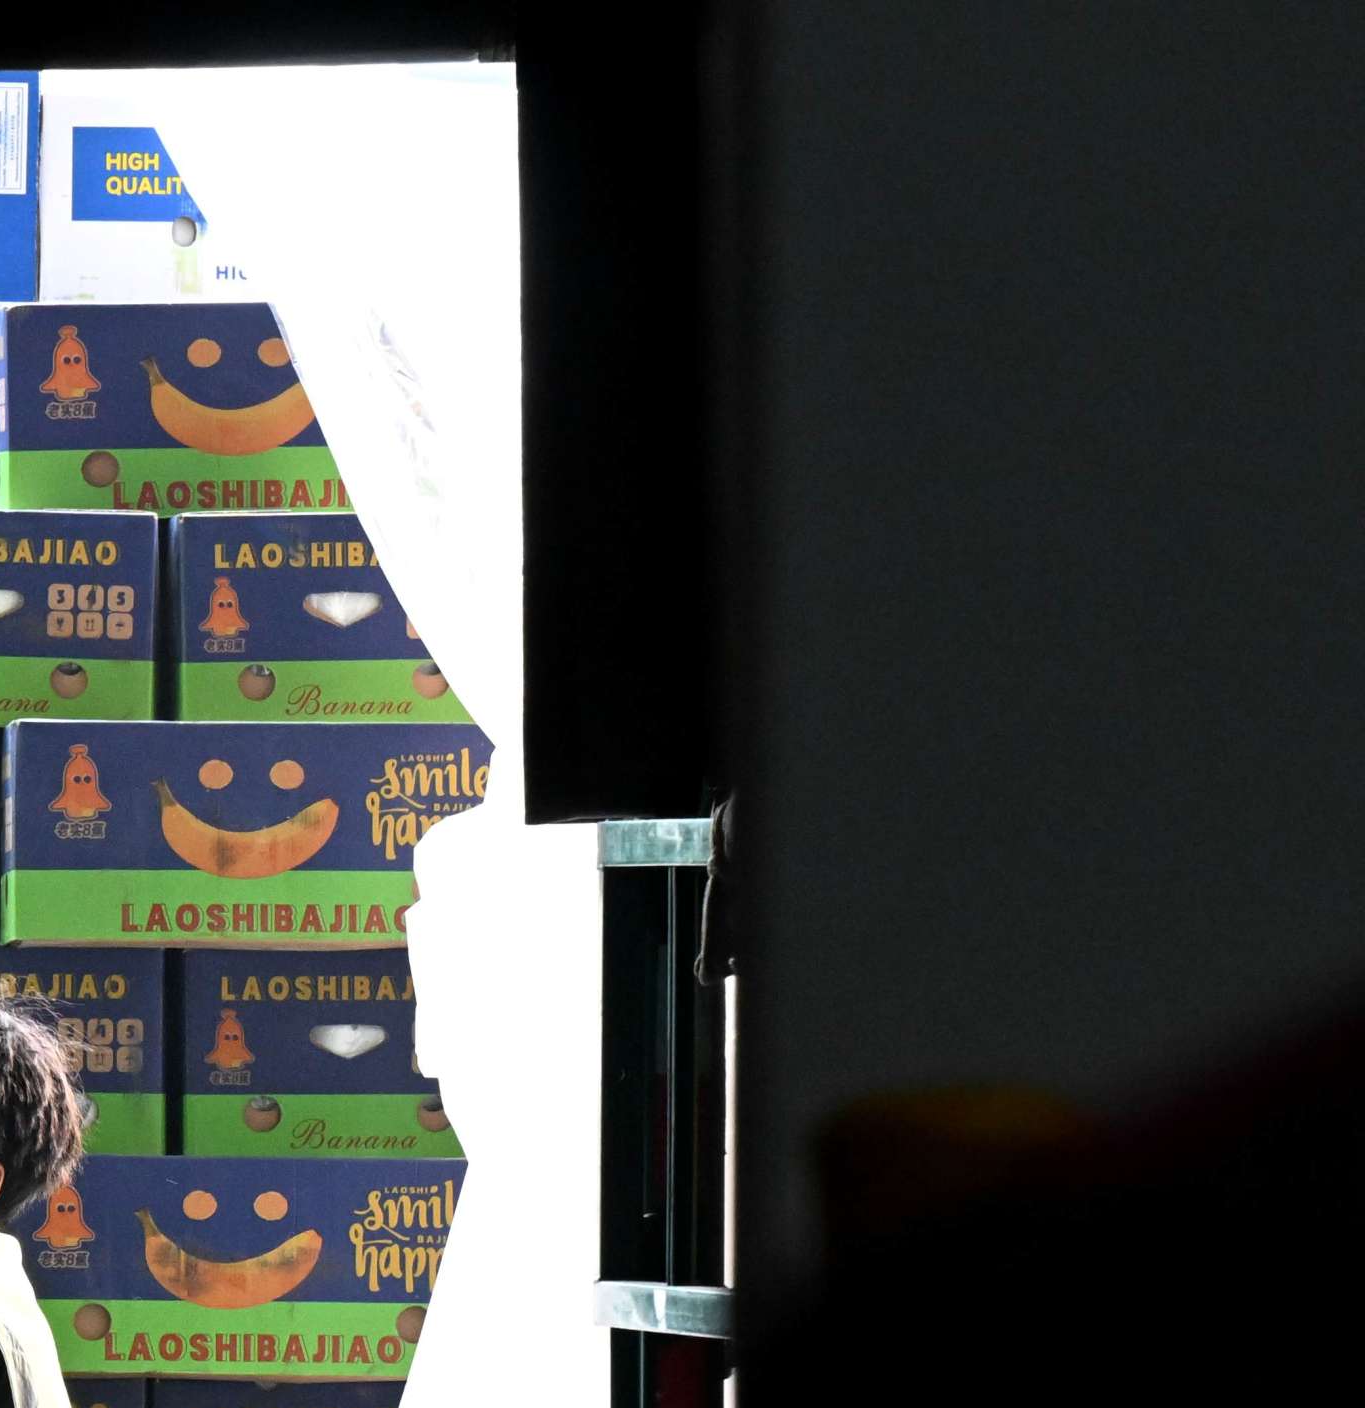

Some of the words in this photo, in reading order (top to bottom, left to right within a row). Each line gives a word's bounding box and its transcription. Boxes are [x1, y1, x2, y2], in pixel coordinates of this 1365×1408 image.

[105, 153, 160, 171] HIGH
[105, 176, 186, 195] QUALIT
[113, 480, 353, 510] LAOSHIBAJI
[214, 542, 381, 569] LAOSHIB
[286, 684, 414, 716] Banana
[291, 1119, 419, 1150] Banana
[105, 1332, 402, 1365] LAOSHIBAJIAO
